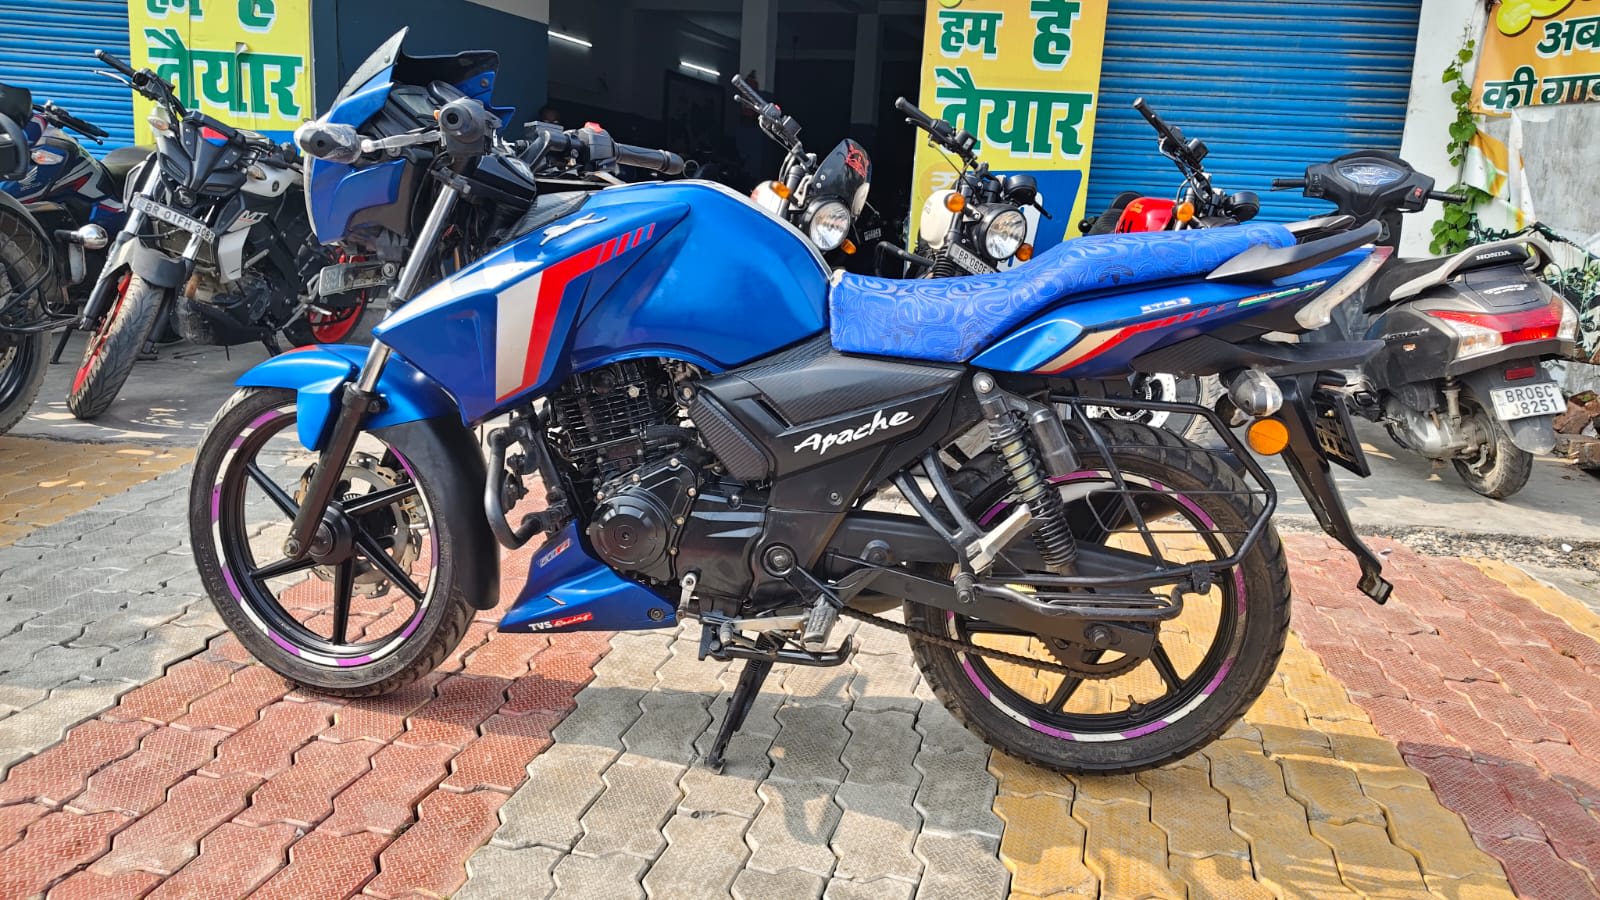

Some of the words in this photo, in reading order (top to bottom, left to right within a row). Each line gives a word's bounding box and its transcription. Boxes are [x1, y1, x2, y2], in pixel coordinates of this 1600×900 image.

[938, 10, 1004, 59] हम
[1029, 0, 1081, 71] ह
[144, 28, 304, 120] तैयार
[1481, 65, 1537, 112] की
[935, 67, 1094, 160] तैयार
[144, 202, 160, 216] BR
[1475, 250, 1512, 260] HONDA
[1505, 385, 1553, 403] BR06C
[1512, 398, 1558, 416] J8251
[793, 409, 915, 455] Apache
[528, 621, 553, 631] TVS
